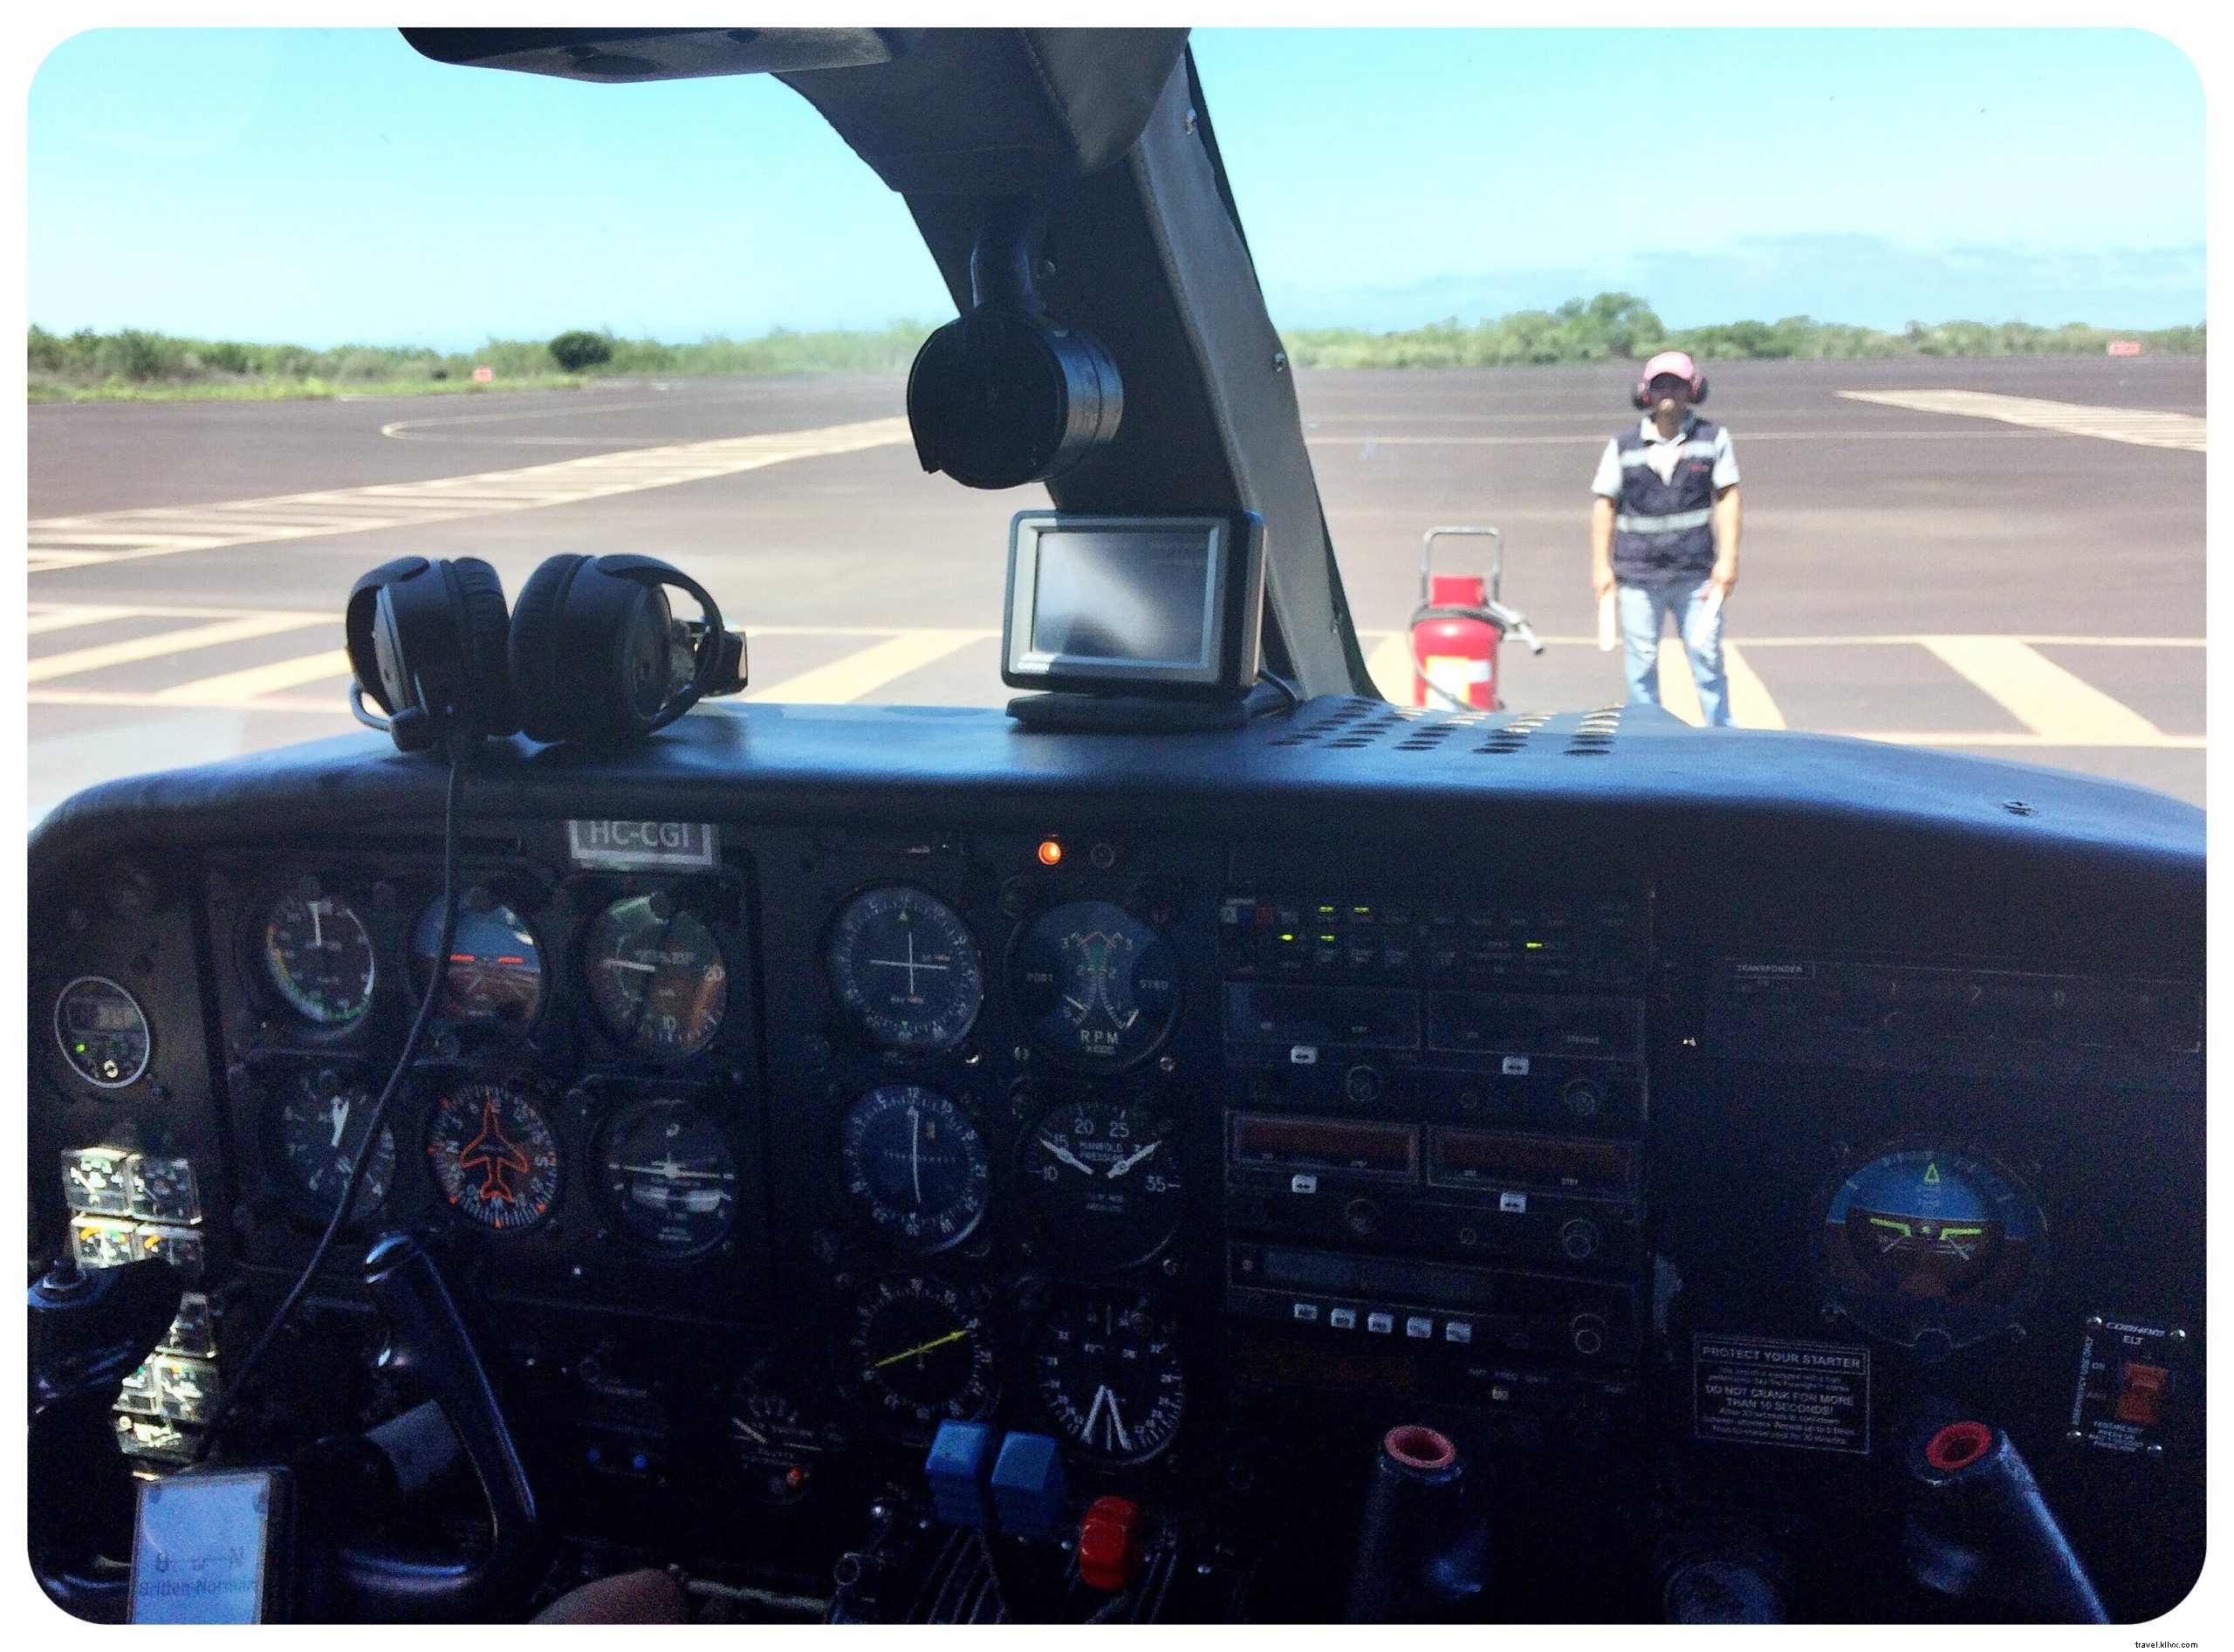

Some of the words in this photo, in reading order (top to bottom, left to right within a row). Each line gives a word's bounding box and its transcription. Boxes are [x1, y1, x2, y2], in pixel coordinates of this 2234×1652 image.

[589, 819, 690, 848] HC-CGI
[1079, 1029, 1119, 1045] RPM
[1073, 1117, 1095, 1135] 20
[1108, 1120, 1130, 1138] 25
[2121, 1334, 2145, 1346] ELT
[1702, 1346, 1760, 1361] PROTECT
[1763, 1350, 1800, 1364] YOUR
[1802, 1354, 1861, 1368] STARTER
[1724, 1386, 1748, 1396] NOT
